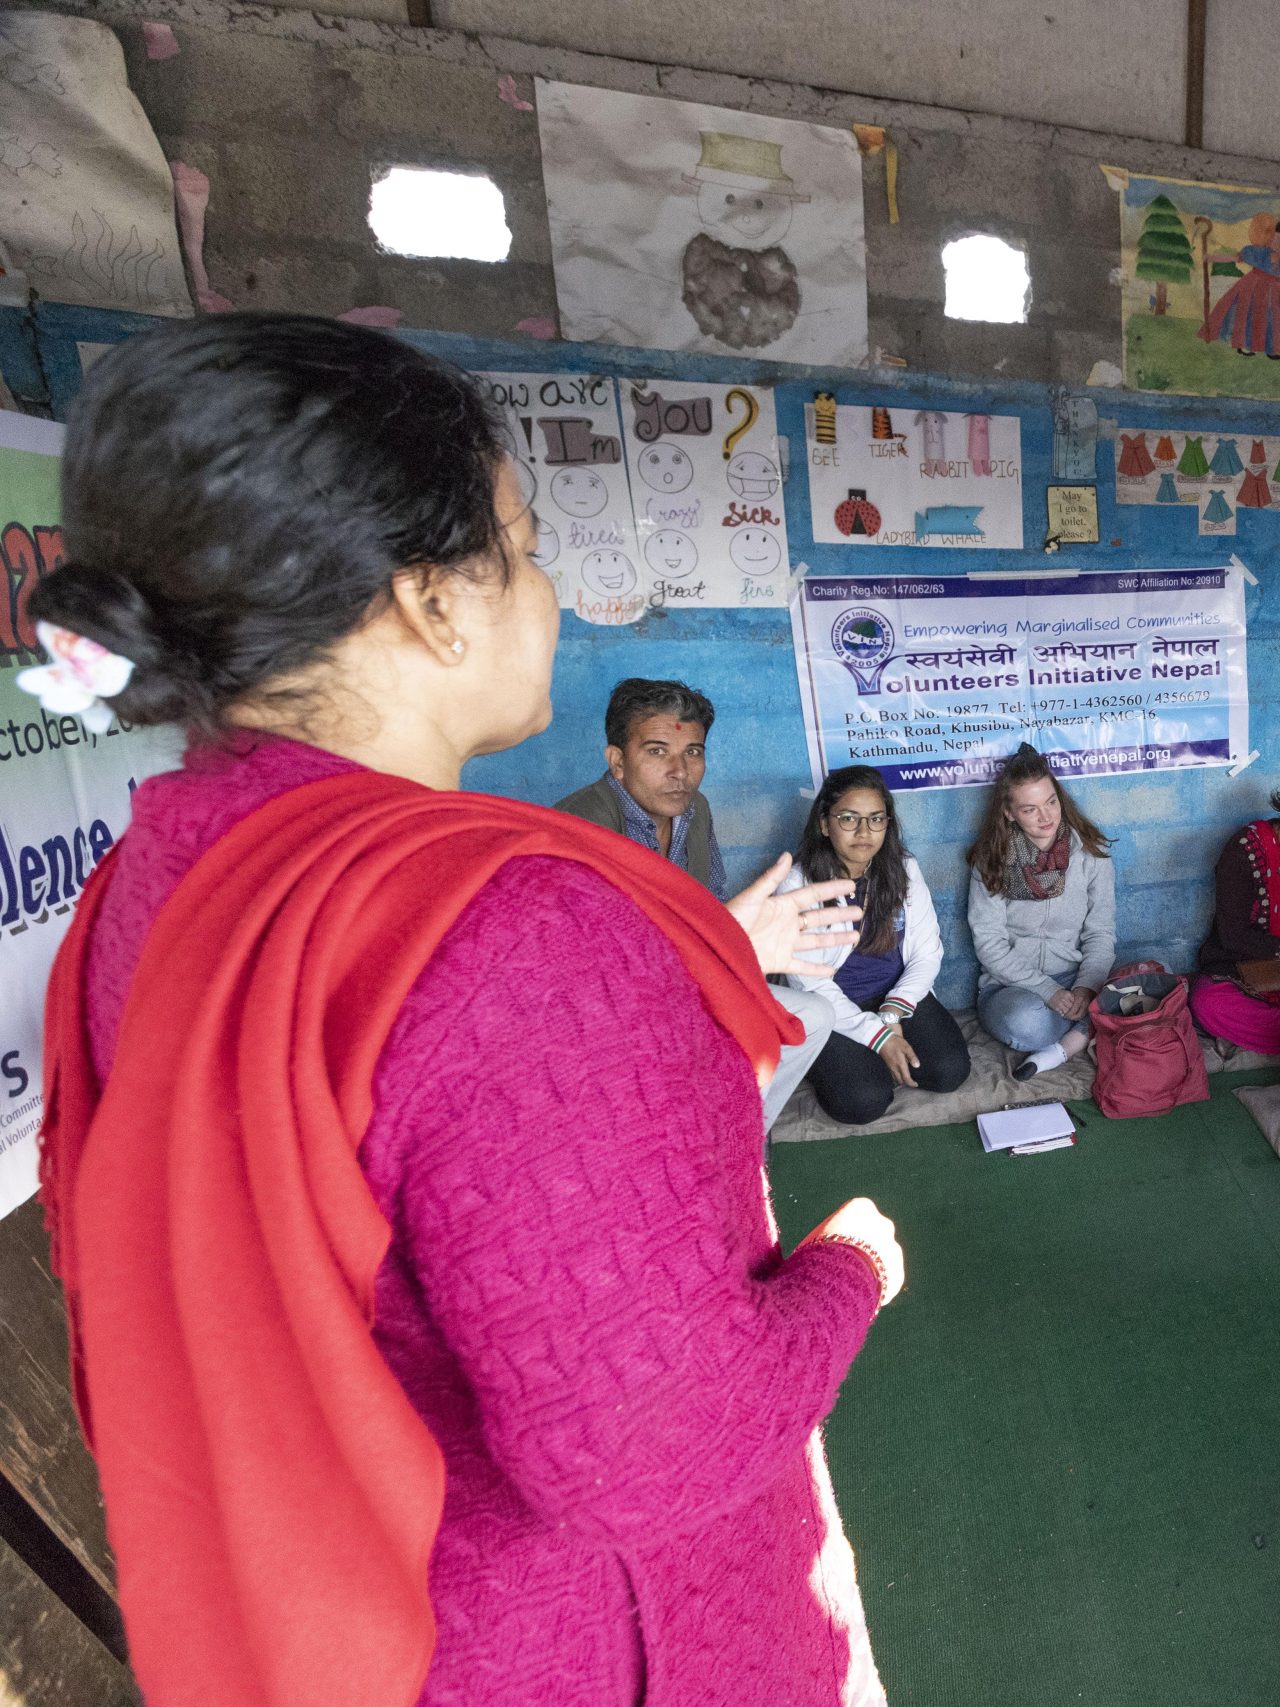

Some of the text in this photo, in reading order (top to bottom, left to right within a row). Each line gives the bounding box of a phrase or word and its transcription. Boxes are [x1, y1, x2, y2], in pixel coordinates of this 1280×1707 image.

[493, 384, 529, 407] ow
[990, 460, 1019, 484] PIG
[1062, 491, 1081, 502] May
[1065, 506, 1077, 515] go
[1078, 505, 1088, 513] to
[812, 585, 848, 598] Charity
[892, 583, 945, 595] 147/062/63
[1117, 575, 1221, 589] SWC Affiliation No: 20910
[904, 611, 1221, 638] Empowering Marginalised Communities
[847, 633, 877, 645] VIN
[904, 636, 1220, 670] स्वयंसेवी अभियान नेपाल
[1029, 665, 1142, 685] Initiative
[1151, 660, 1221, 680] Nepal
[914, 708, 940, 720] No.
[999, 702, 1026, 714] Tel:
[1031, 694, 1142, 712] +977-1-4362560
[1155, 690, 1211, 703] 4356679
[0, 708, 97, 761] ctober,
[847, 708, 1156, 742] Pahiko Road, Khusibu, Nayabazar, KMC-16
[849, 737, 984, 759] Kathmandu, Nepal
[0, 818, 114, 926] lence
[6, 1116, 44, 1147] Volunta
